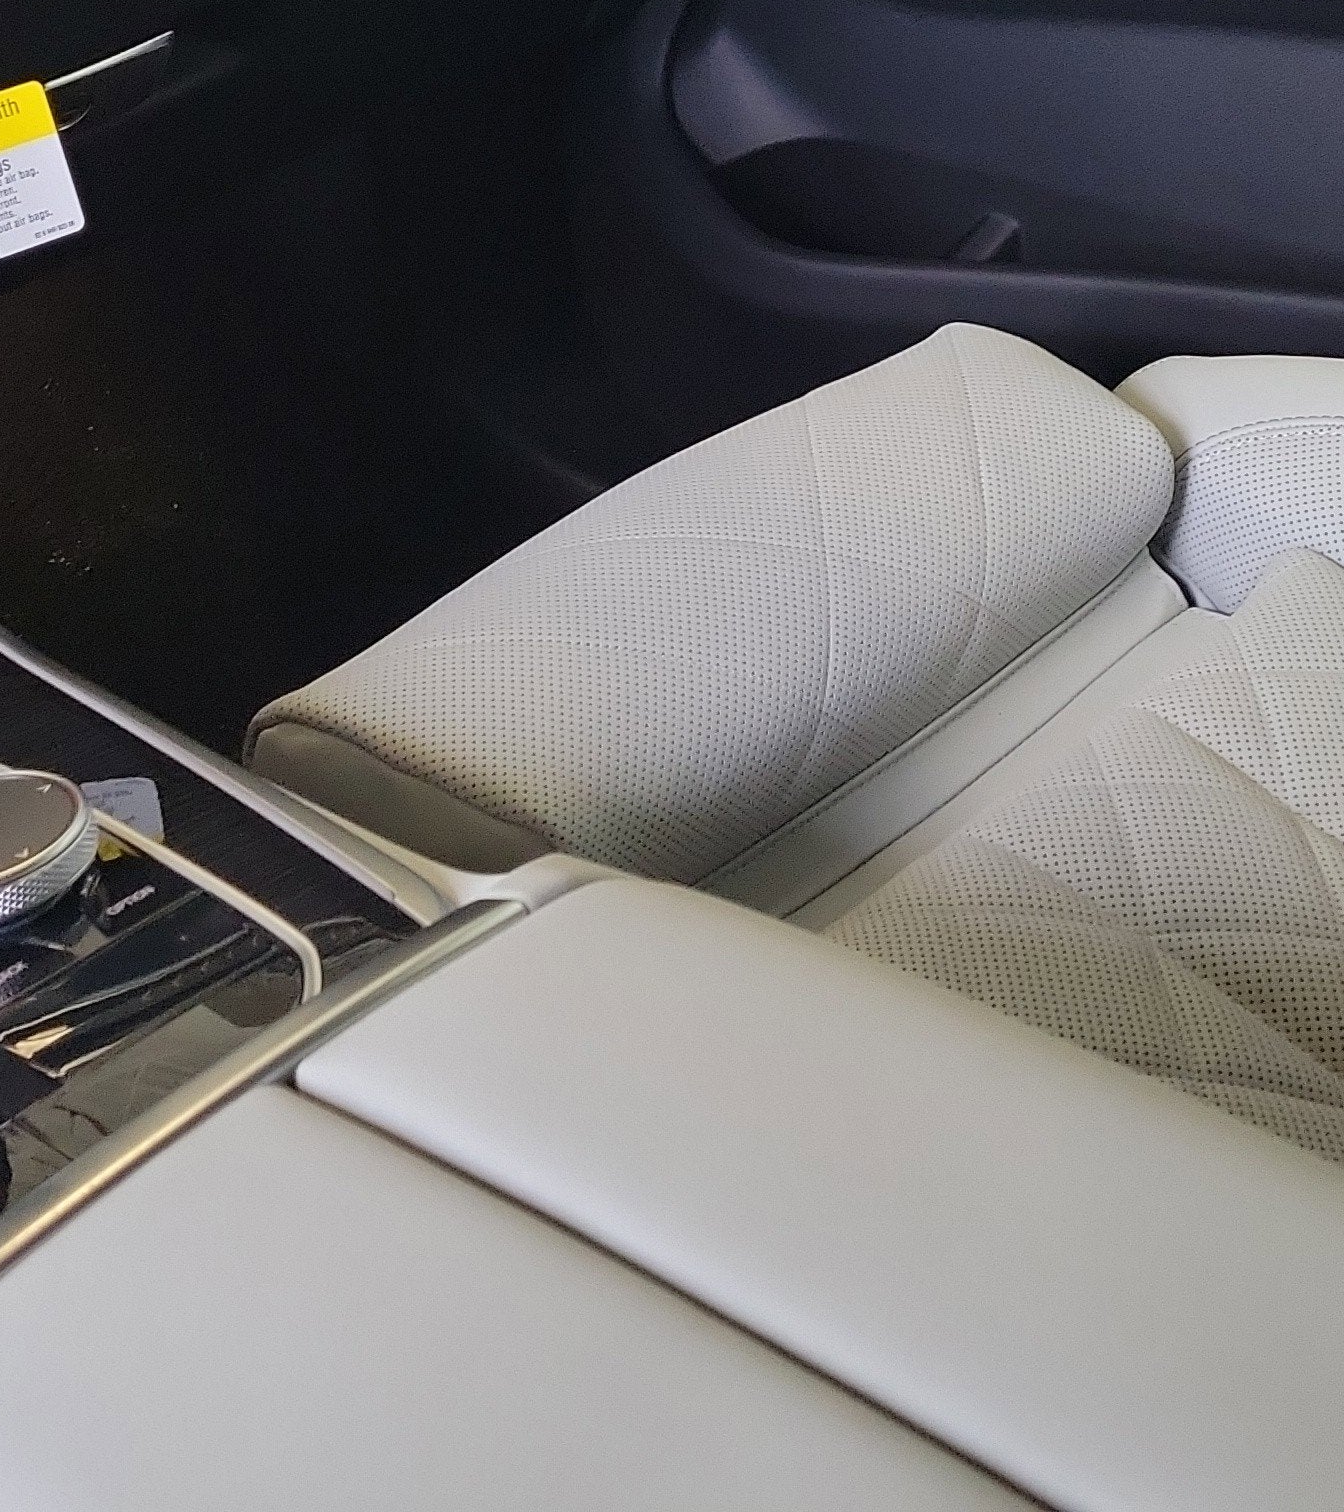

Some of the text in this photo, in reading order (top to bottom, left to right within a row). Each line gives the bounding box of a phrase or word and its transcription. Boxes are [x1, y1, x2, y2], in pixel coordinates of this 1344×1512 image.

[4, 173, 17, 185] air
[17, 167, 39, 180] bag.
[13, 217, 26, 228] air
[27, 209, 53, 223] bags.
